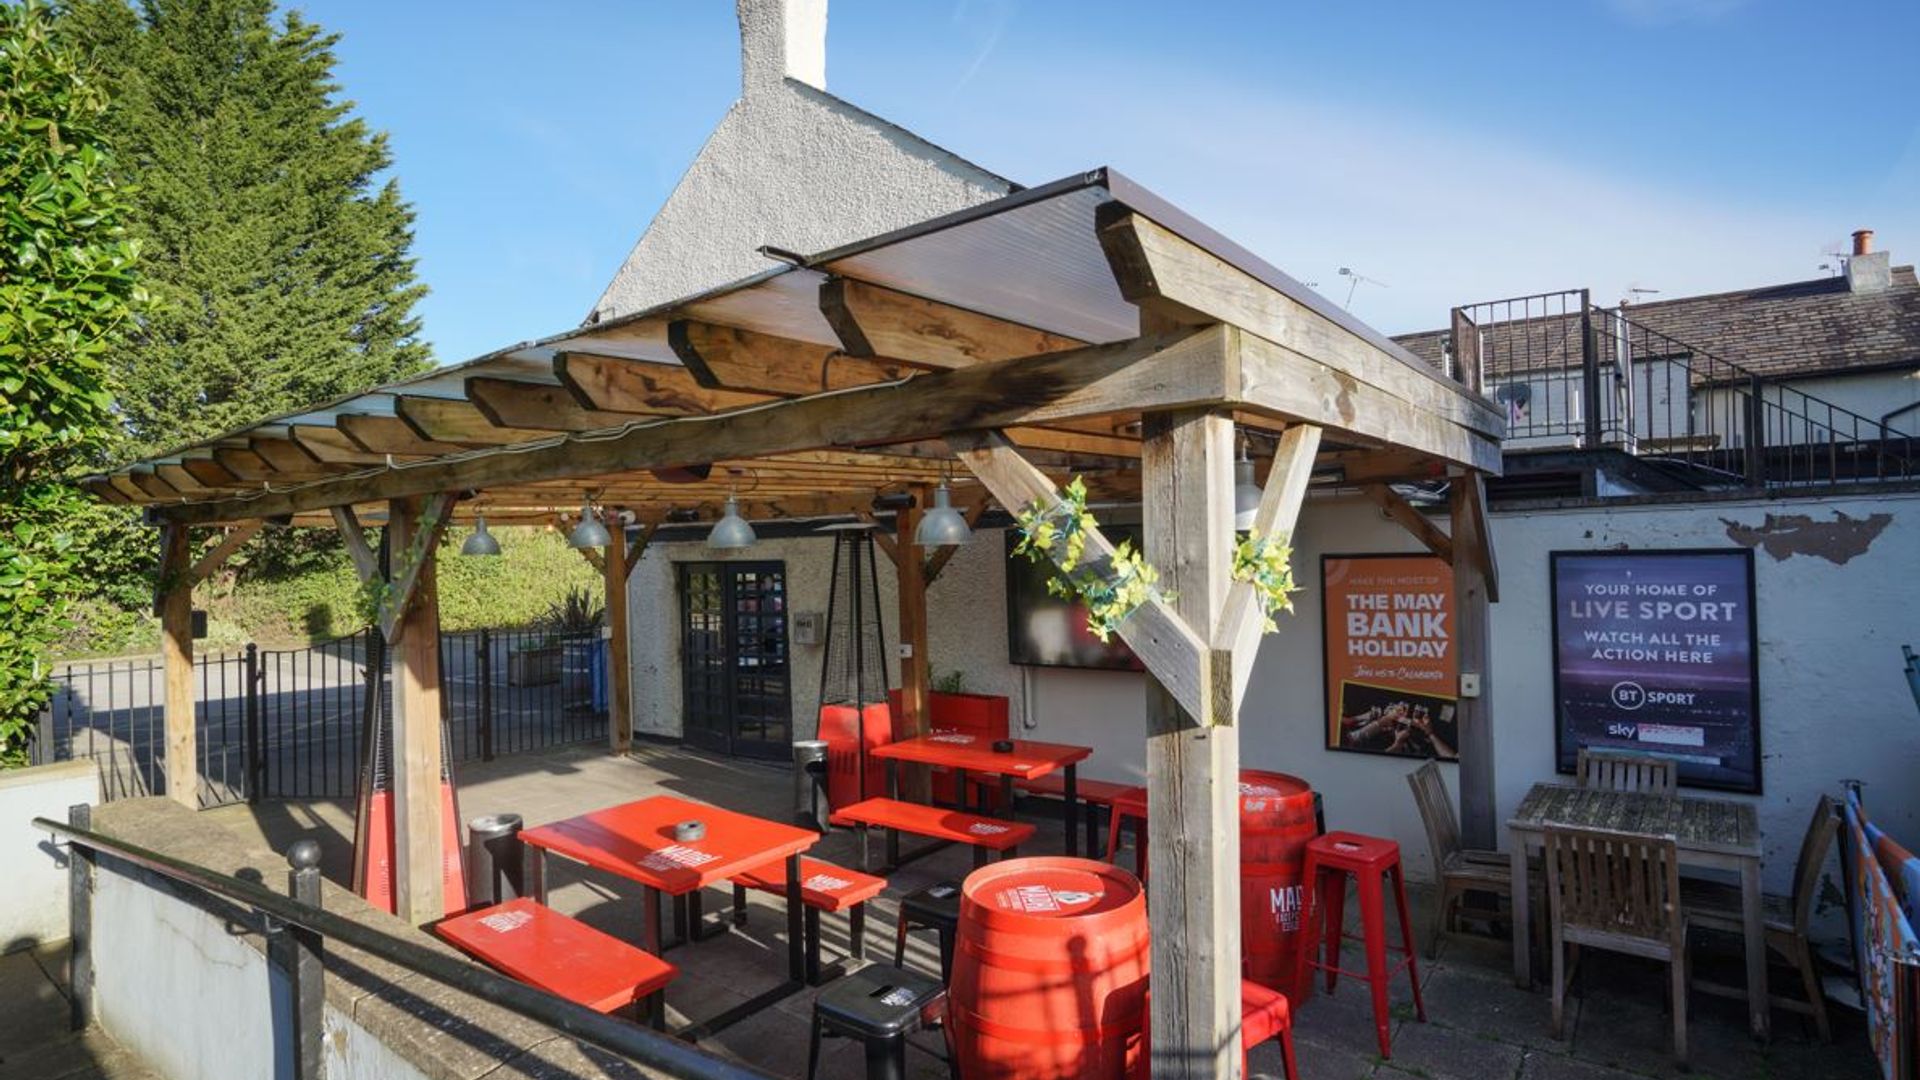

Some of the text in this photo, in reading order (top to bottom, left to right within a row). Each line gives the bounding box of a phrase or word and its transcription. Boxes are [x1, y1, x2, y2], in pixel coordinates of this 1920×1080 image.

[1584, 584, 1718, 597] YOUR HOME OF
[1346, 594, 1445, 611] THE MAY
[1570, 600, 1737, 622] LIVE SPORT
[1346, 612, 1449, 638] BANK
[1584, 631, 1721, 647] WATCH ALL THE
[1347, 640, 1449, 658] HOLIDAY
[1591, 648, 1713, 664] ACTION HERE
[1618, 690, 1696, 706] BT SPORT
[1608, 723, 1637, 739] sky
